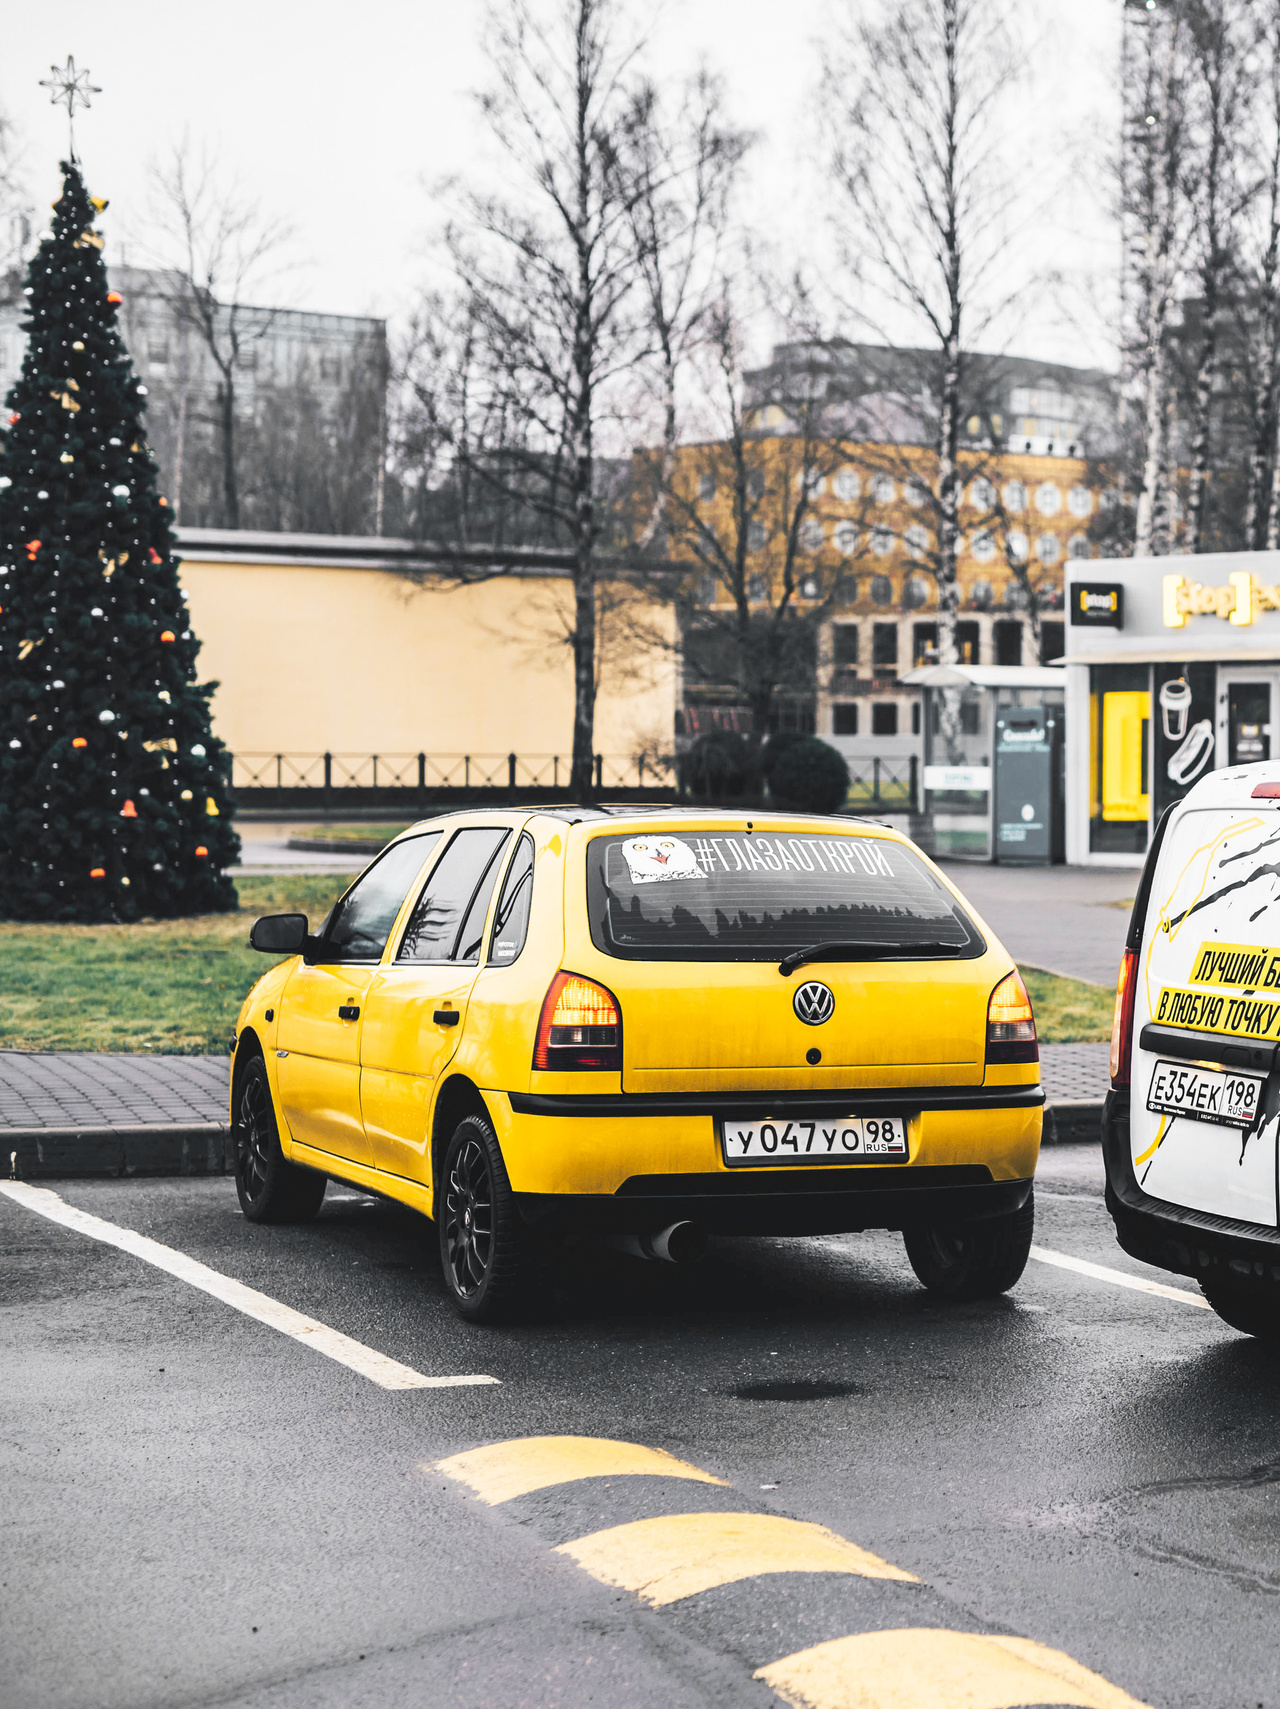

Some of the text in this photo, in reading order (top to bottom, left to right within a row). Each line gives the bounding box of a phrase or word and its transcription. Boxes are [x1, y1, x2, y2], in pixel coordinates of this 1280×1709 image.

[694, 837, 896, 878] #ГЛАЗАОТКРОЙ
[1194, 948, 1268, 987] ЛУЧШИЙ
[1157, 990, 1170, 1021] В
[1166, 992, 1225, 1028] ЛЮБУЮ
[1223, 999, 1280, 1036] ТОЧКУ
[1226, 1079, 1256, 1108] 198
[1227, 1104, 1243, 1117] RUS
[866, 1120, 895, 1143] 98
[866, 1143, 888, 1152] RUS
